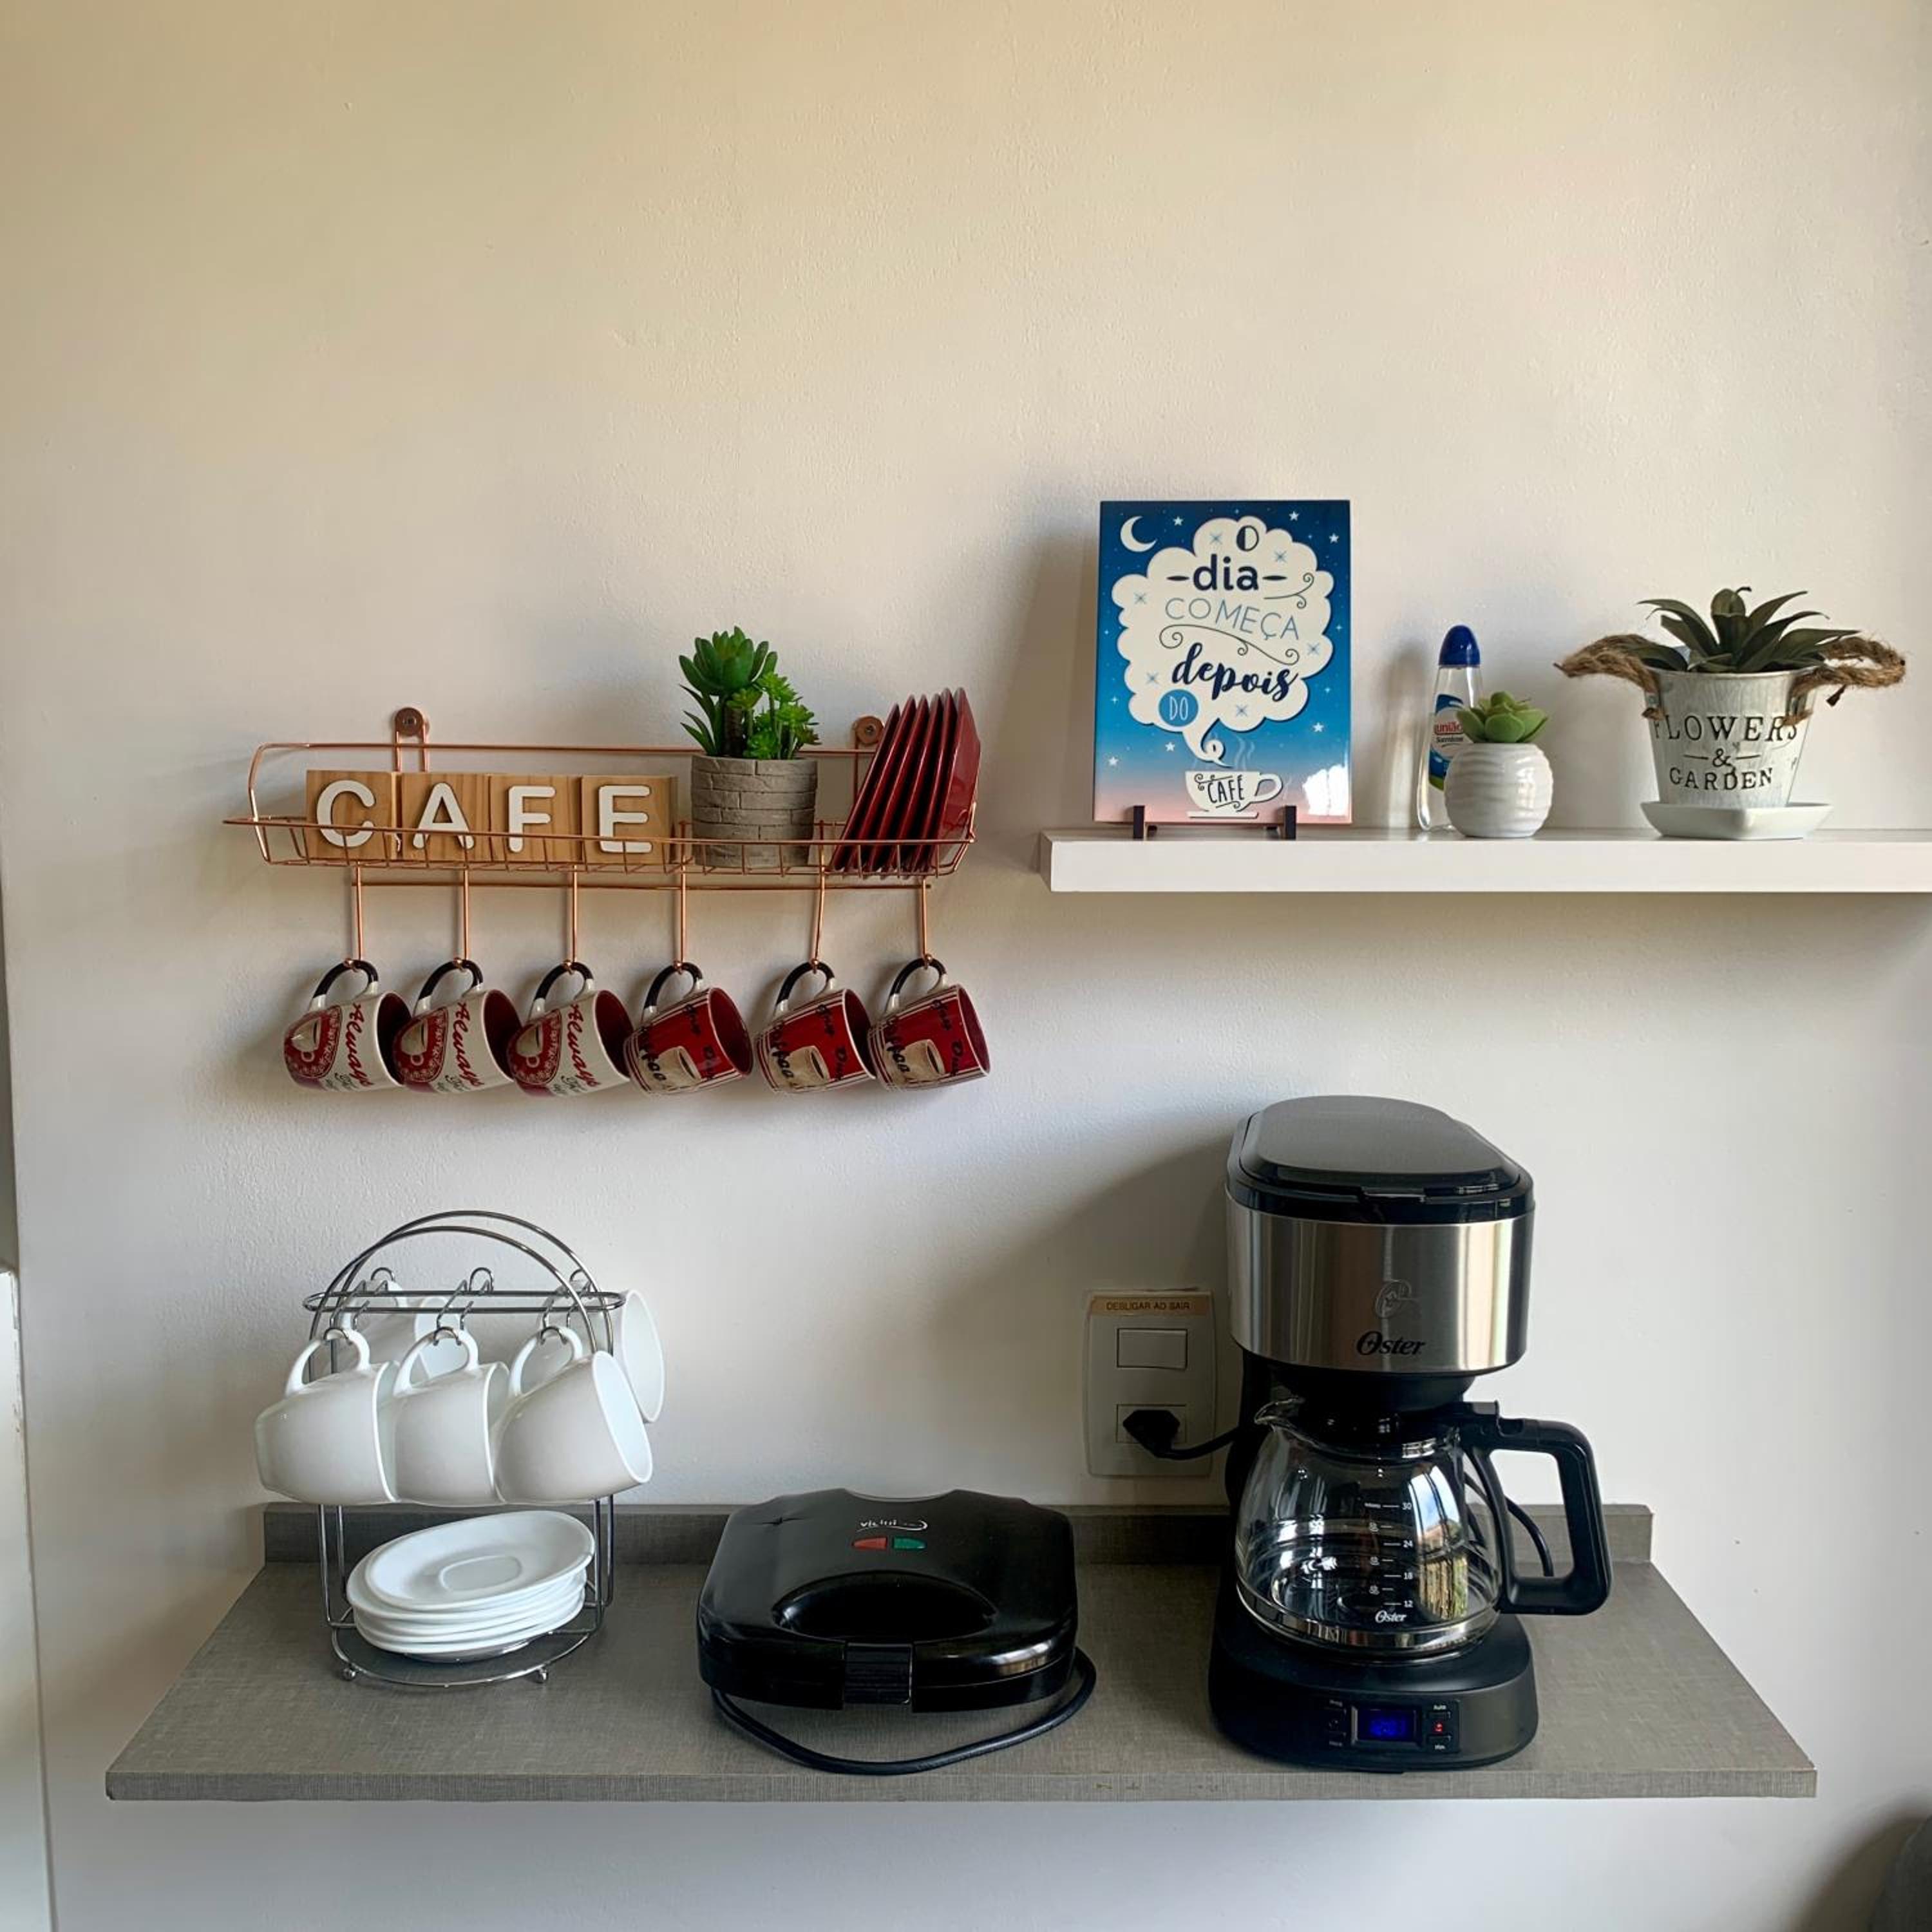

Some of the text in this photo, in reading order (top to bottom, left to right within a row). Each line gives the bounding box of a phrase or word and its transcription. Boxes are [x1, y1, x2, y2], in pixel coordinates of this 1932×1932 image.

[1236, 524, 1260, 552] O
[1193, 553, 1259, 591] dia
[1164, 597, 1300, 641] COMEÇA
[1171, 642, 1299, 702] depois
[1169, 699, 1189, 721] DO
[1712, 748, 1734, 768] &
[1669, 766, 1773, 791] GARDEN
[1106, 1301, 1190, 1311] DESLIGAR AO SAIR
[1356, 1331, 1426, 1356] Oster
[1402, 1502, 1412, 1510] 30
[1403, 1540, 1413, 1548] 24
[1403, 1600, 1414, 1608] 12
[1375, 1609, 1407, 1624] Oster
